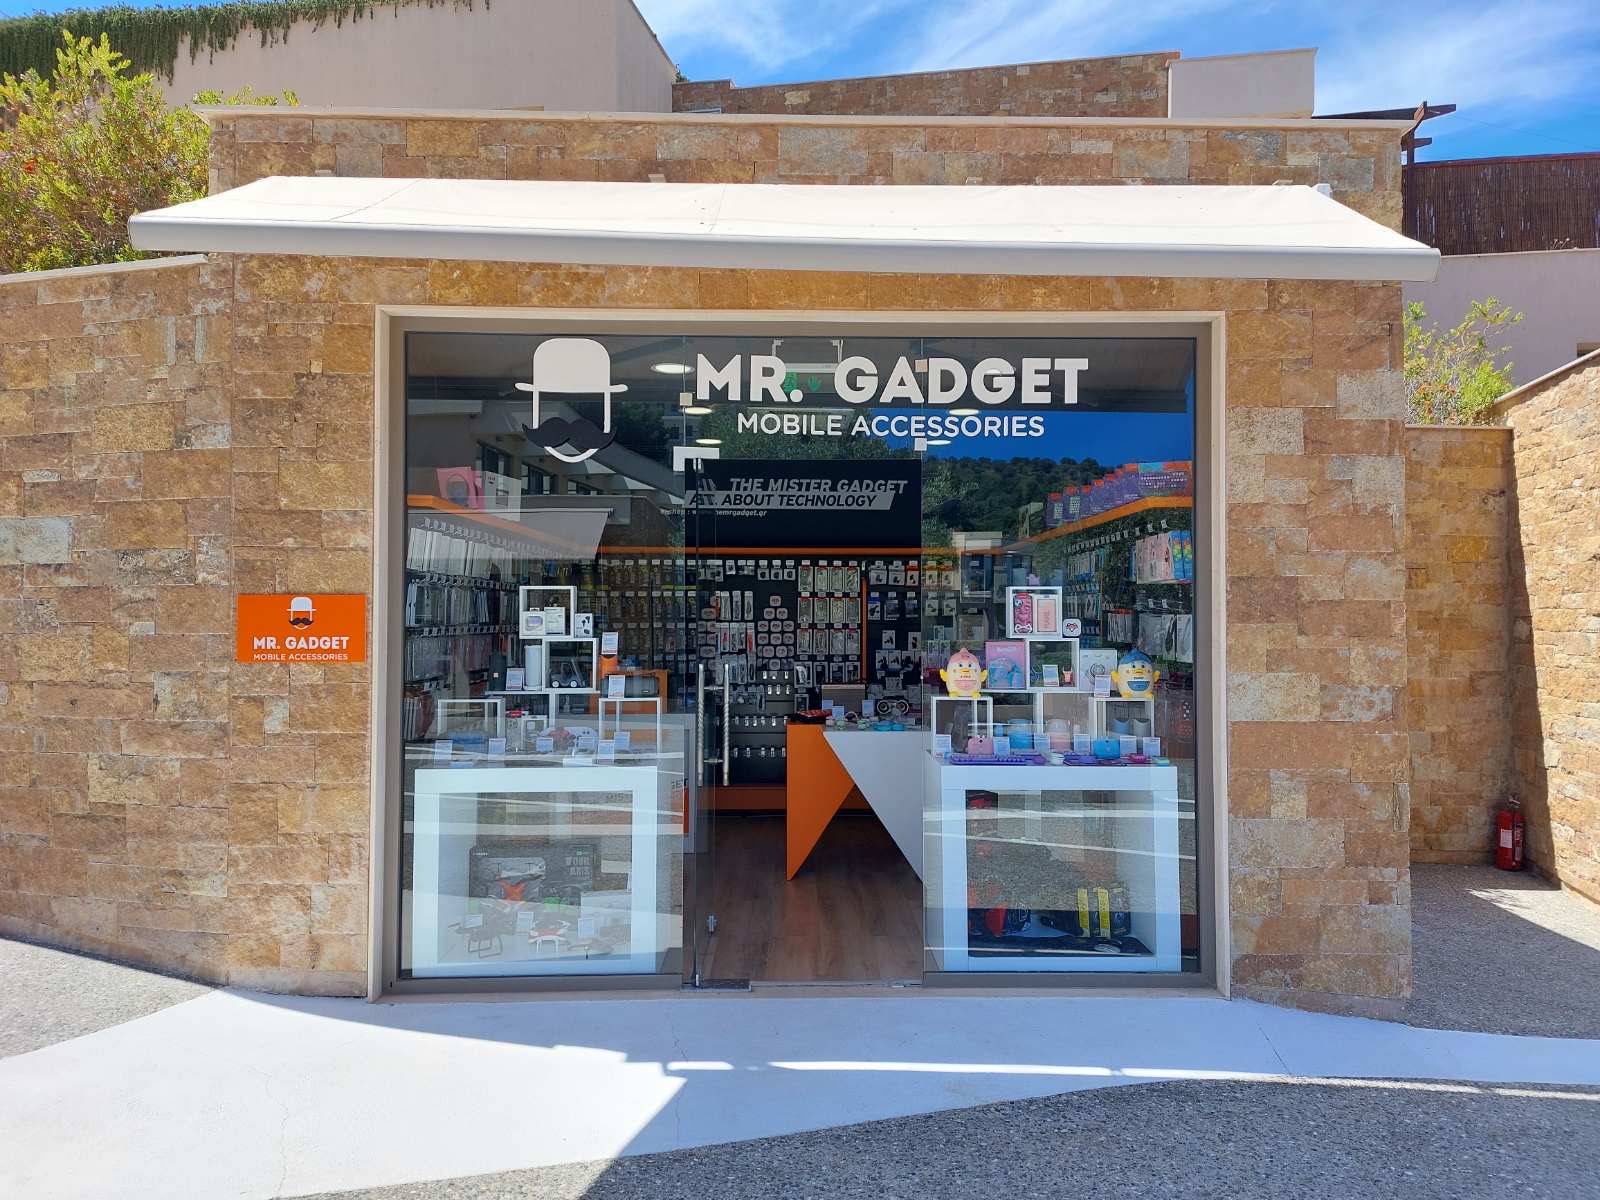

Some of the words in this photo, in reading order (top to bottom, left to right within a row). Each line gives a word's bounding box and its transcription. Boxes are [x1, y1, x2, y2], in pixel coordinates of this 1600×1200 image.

[696, 353, 804, 402] MR.
[834, 356, 1089, 404] GADGET
[737, 412, 842, 436] MOBILE
[852, 415, 1045, 437] ACCESSORIES
[730, 478, 764, 492] THE
[768, 478, 832, 493] MISTER
[836, 479, 908, 494] GADGET
[721, 494, 774, 506] ABOUT
[778, 494, 877, 507] TECHNOLOGY
[253, 636, 281, 650] MR.
[285, 636, 350, 650] GADGET
[253, 653, 286, 661] MOBILE
[288, 653, 348, 661] ACCESSORIES
